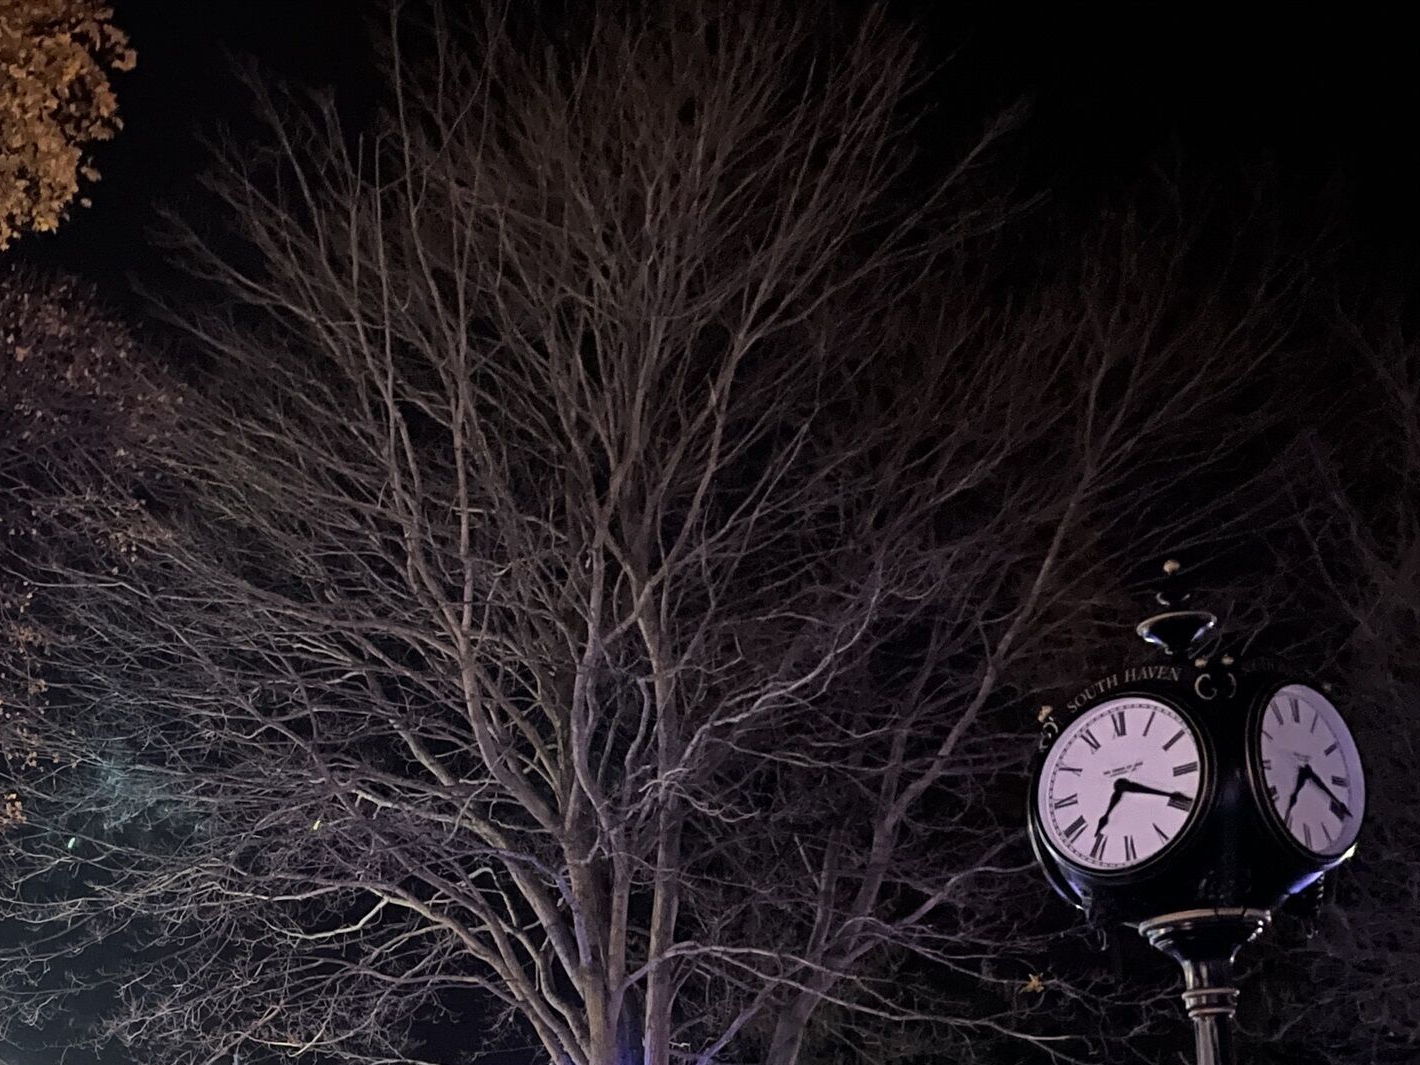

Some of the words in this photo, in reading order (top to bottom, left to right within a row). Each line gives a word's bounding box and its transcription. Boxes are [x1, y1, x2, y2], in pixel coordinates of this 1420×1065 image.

[1066, 673, 1119, 713] SOUTH
[1124, 665, 1182, 684] HAVEN
[1142, 711, 1156, 737] I
[1172, 761, 1198, 778] III
